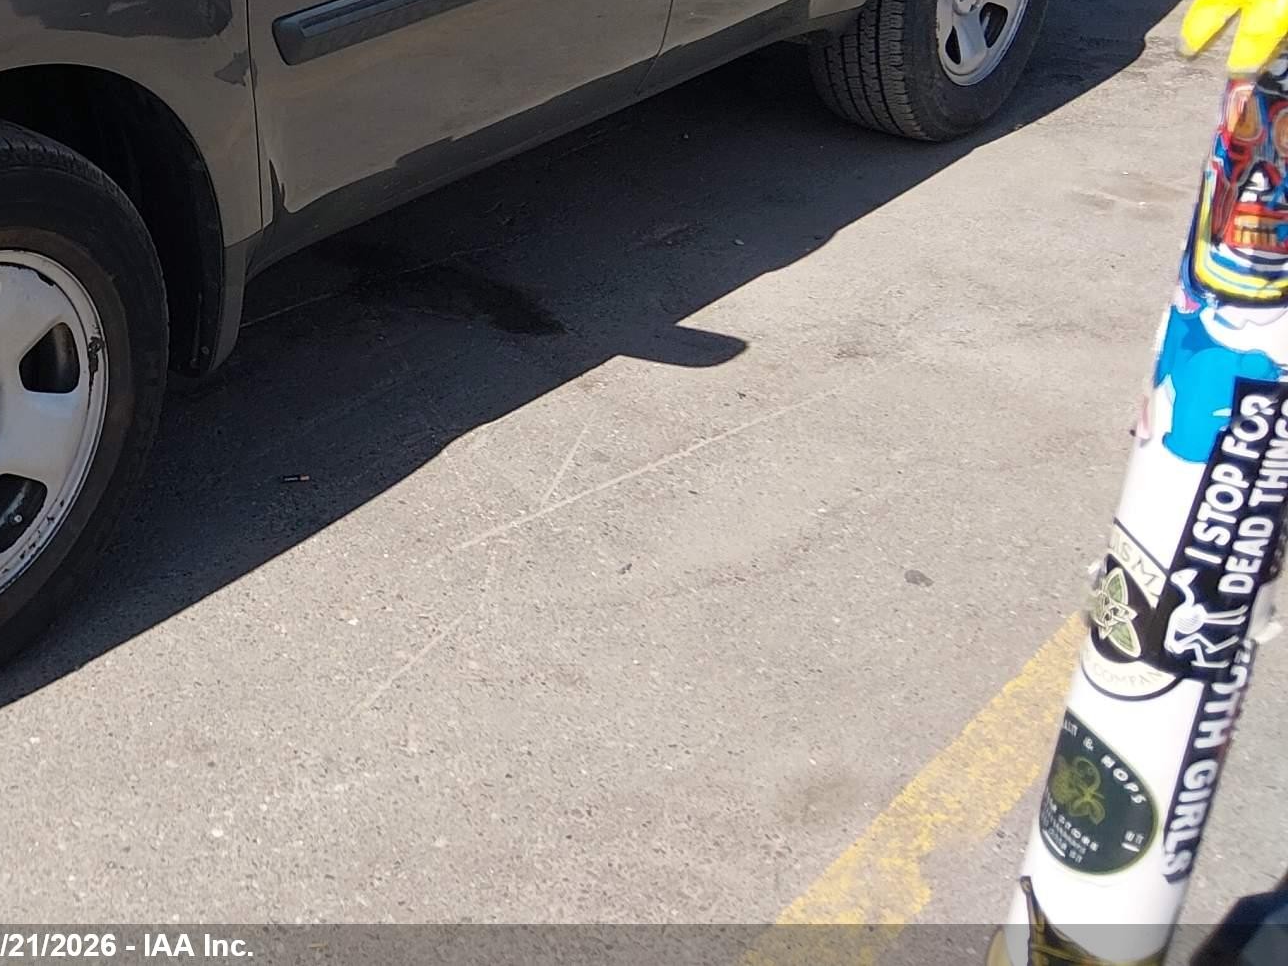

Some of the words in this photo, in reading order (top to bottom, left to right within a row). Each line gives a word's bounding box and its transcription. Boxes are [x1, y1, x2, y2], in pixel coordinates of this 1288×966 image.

[1221, 393, 1278, 460] FOR
[1192, 463, 1250, 546] STOP
[1184, 546, 1223, 565] I
[1218, 516, 1275, 595] DEAD
[1164, 759, 1219, 876] GIRLS
